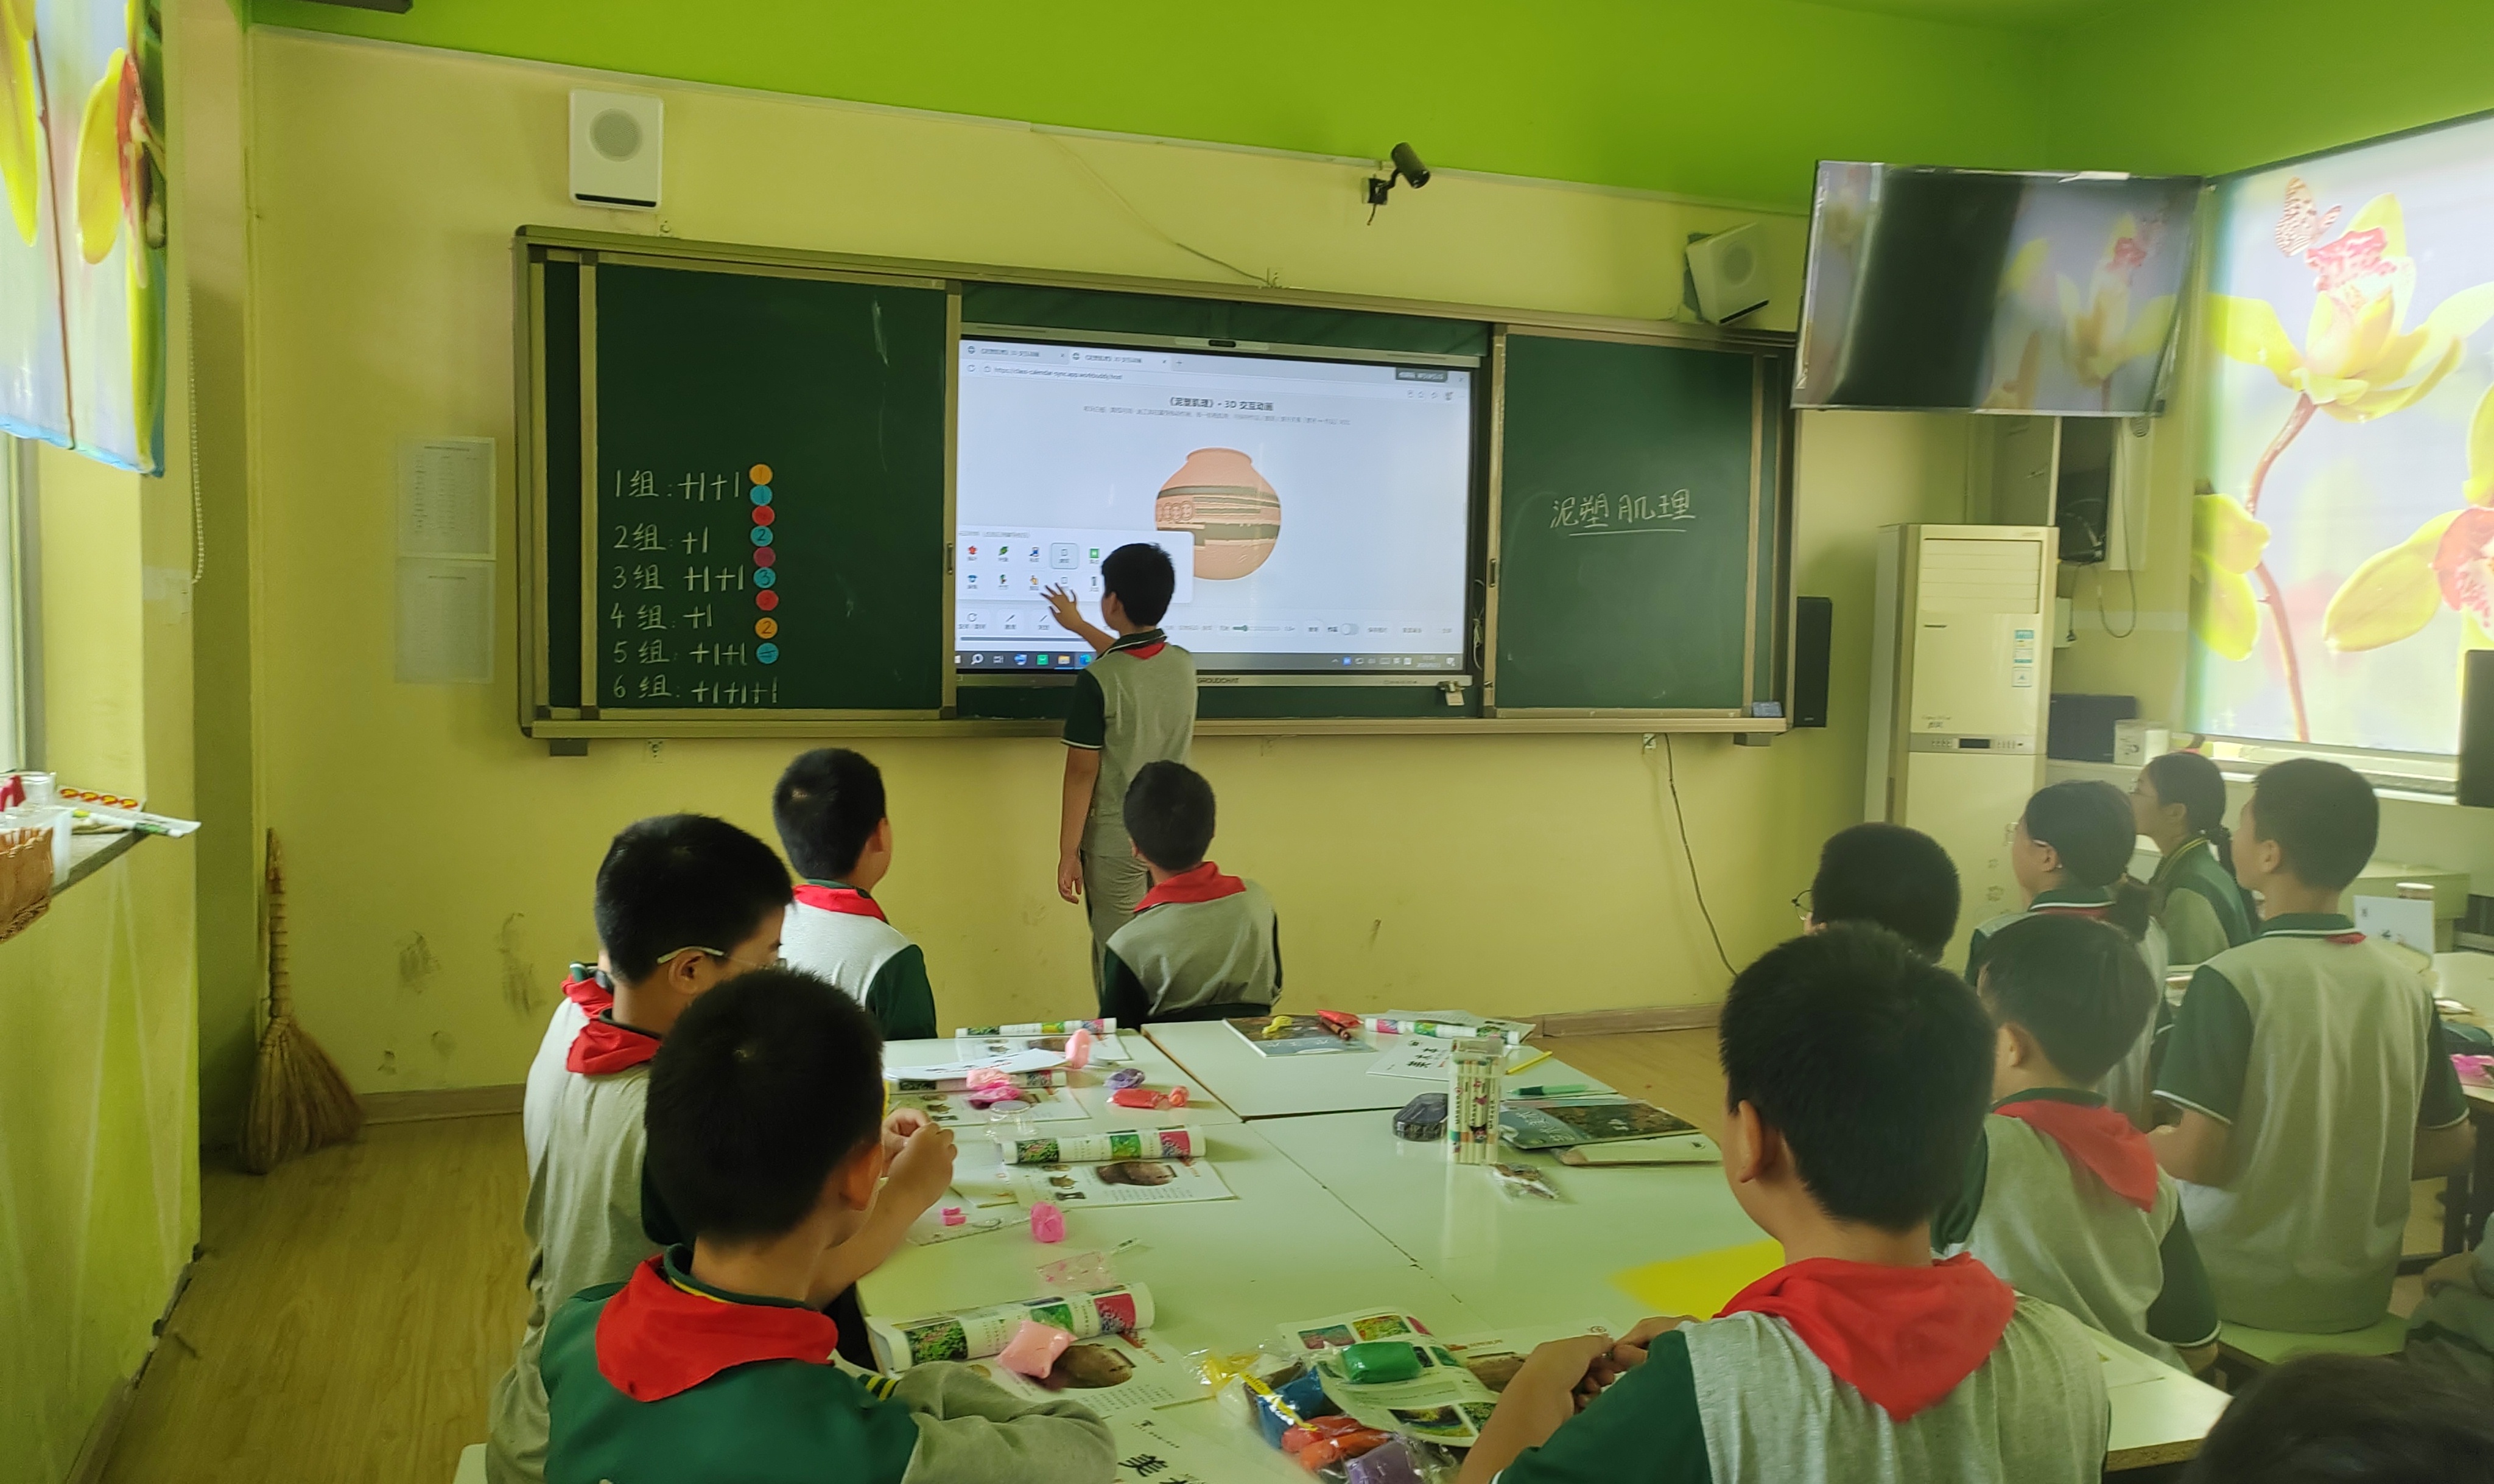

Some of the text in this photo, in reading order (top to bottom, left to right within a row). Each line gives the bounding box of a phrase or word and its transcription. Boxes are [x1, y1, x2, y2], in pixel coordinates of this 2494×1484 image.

[1239, 401, 1274, 411] 交互动画
[1550, 489, 1696, 528] 泥塑肌理
[757, 528, 767, 542] 2
[759, 569, 771, 586] 3
[761, 620, 772, 634] 2
